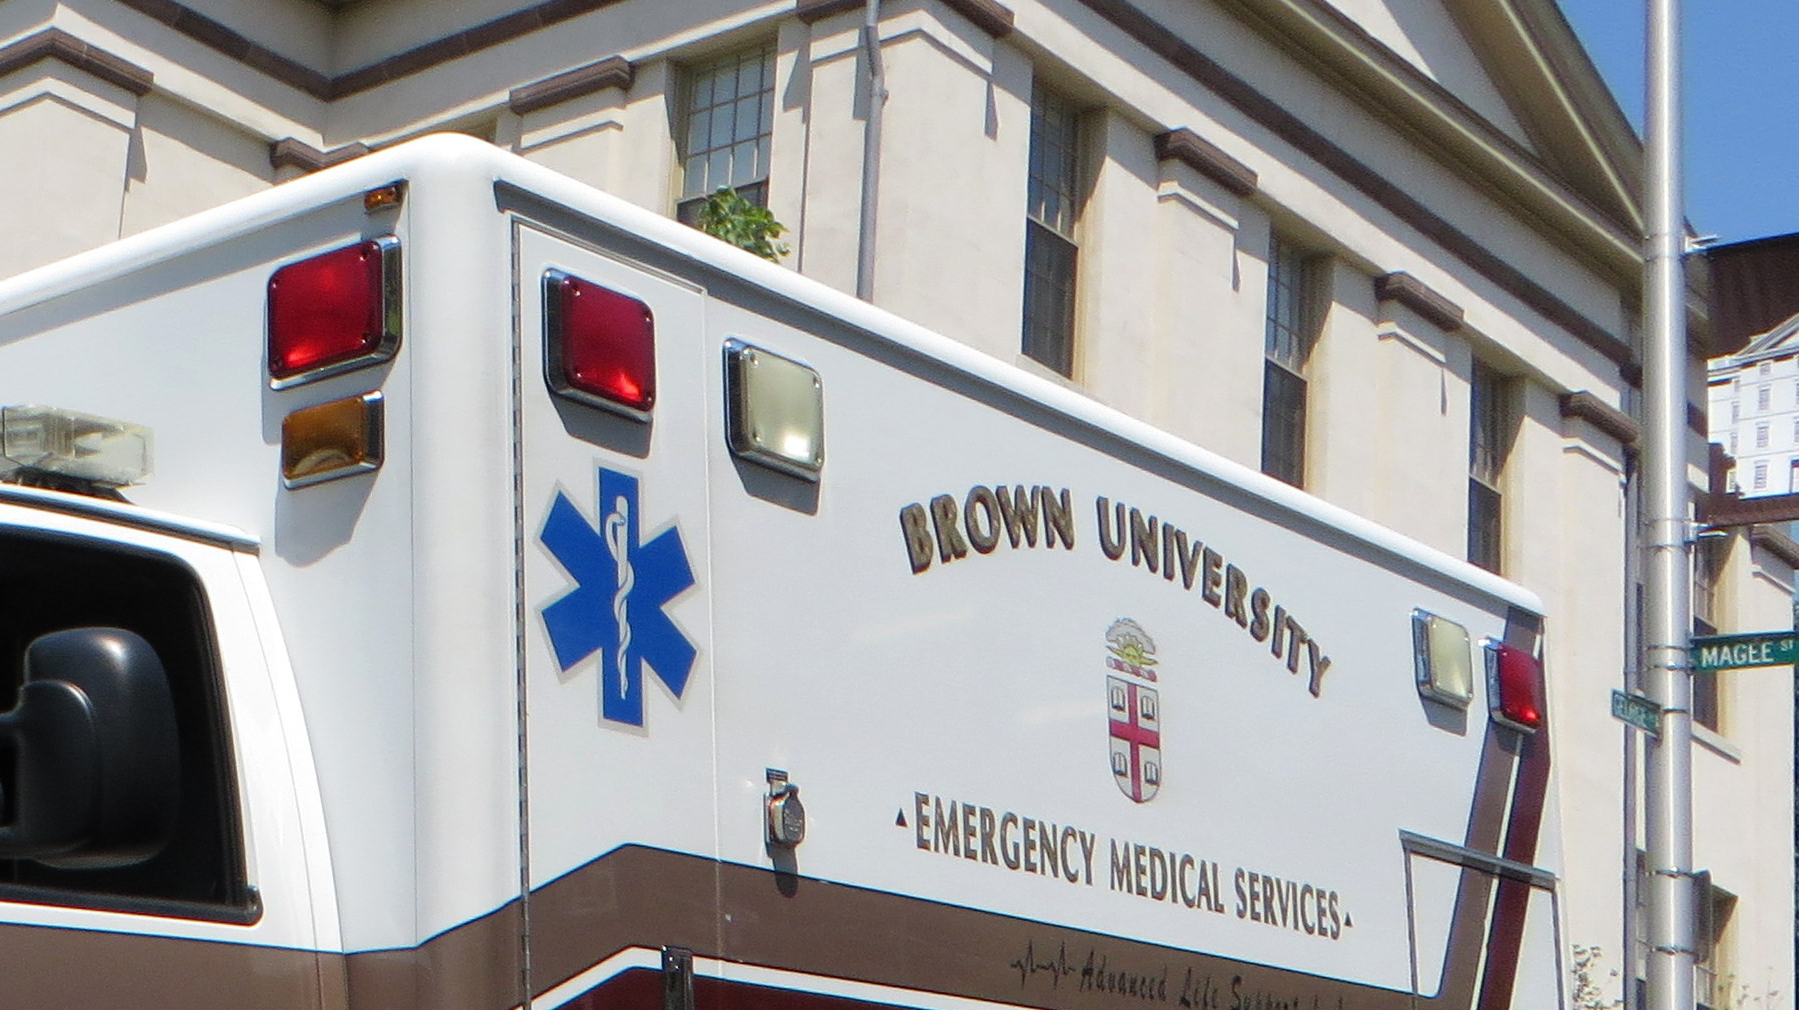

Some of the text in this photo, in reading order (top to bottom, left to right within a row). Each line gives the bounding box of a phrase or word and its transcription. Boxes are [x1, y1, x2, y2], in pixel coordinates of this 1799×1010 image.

[900, 484, 1332, 699] BROWN UNIVERSITY
[1701, 639, 1793, 668] MAGEE ST
[914, 790, 1342, 940] EMERGENCY MEDICAL SERVICES
[1079, 947, 1167, 1003] Advanced
